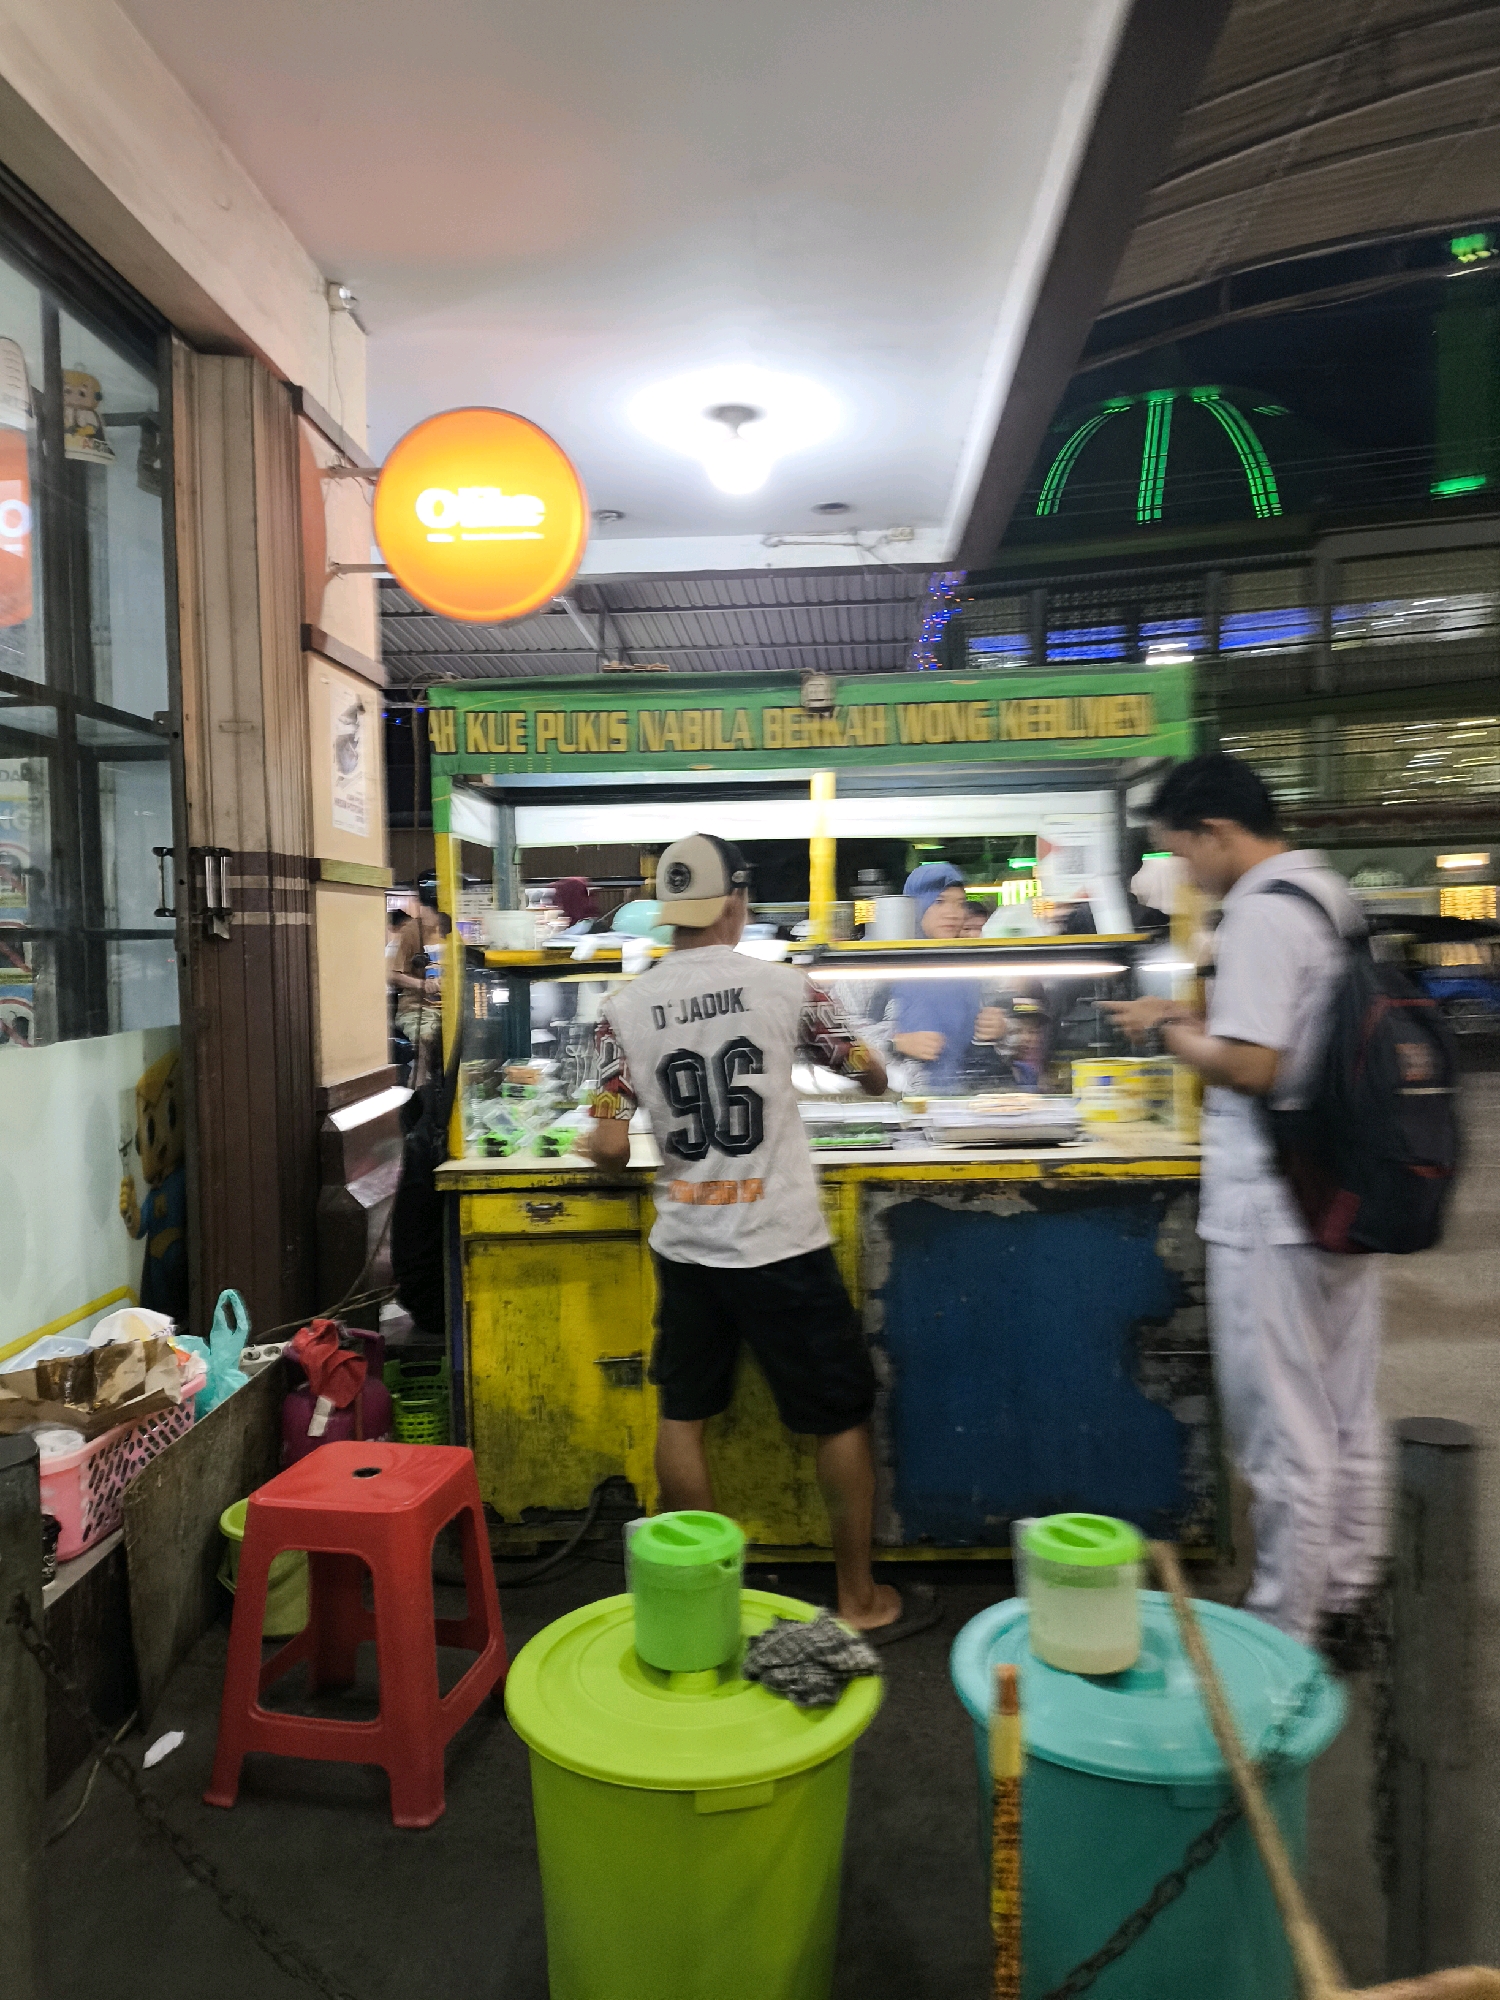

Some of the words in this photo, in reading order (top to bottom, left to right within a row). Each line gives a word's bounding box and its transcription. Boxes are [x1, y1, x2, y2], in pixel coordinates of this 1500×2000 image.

[465, 710, 527, 754] KUE
[535, 709, 629, 754] PUKIS
[638, 707, 751, 752] NABILA
[762, 703, 887, 750] BERKAH
[896, 700, 994, 745] WONG
[999, 692, 1155, 741] KEBUMEN
[655, 1035, 764, 1162] 96
